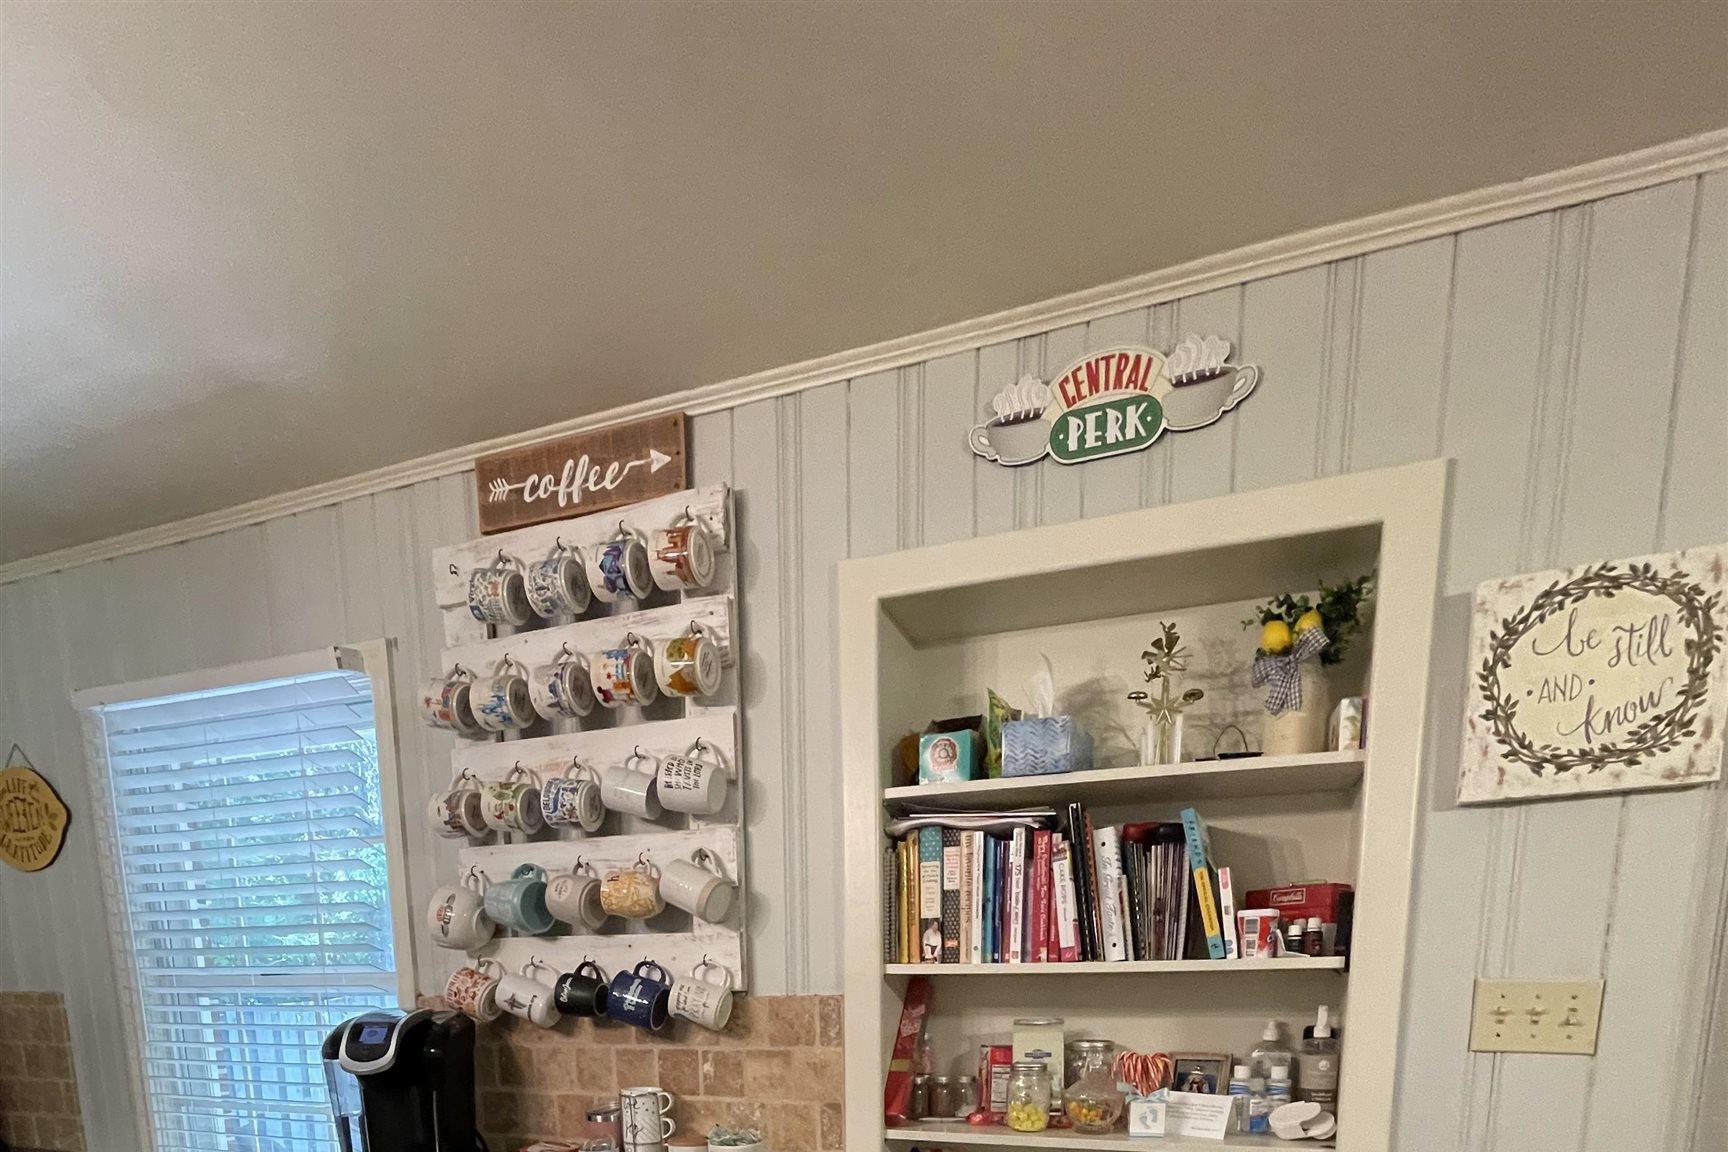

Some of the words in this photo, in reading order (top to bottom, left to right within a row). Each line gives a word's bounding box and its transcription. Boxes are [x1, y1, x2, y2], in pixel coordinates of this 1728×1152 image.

[1057, 352, 1154, 409] CENTRAL
[1067, 402, 1149, 452] PERK
[523, 454, 626, 507] coffee
[1532, 607, 1602, 657] be
[1607, 613, 1674, 668] still
[1537, 673, 1583, 705] AND
[1556, 676, 1675, 744] know
